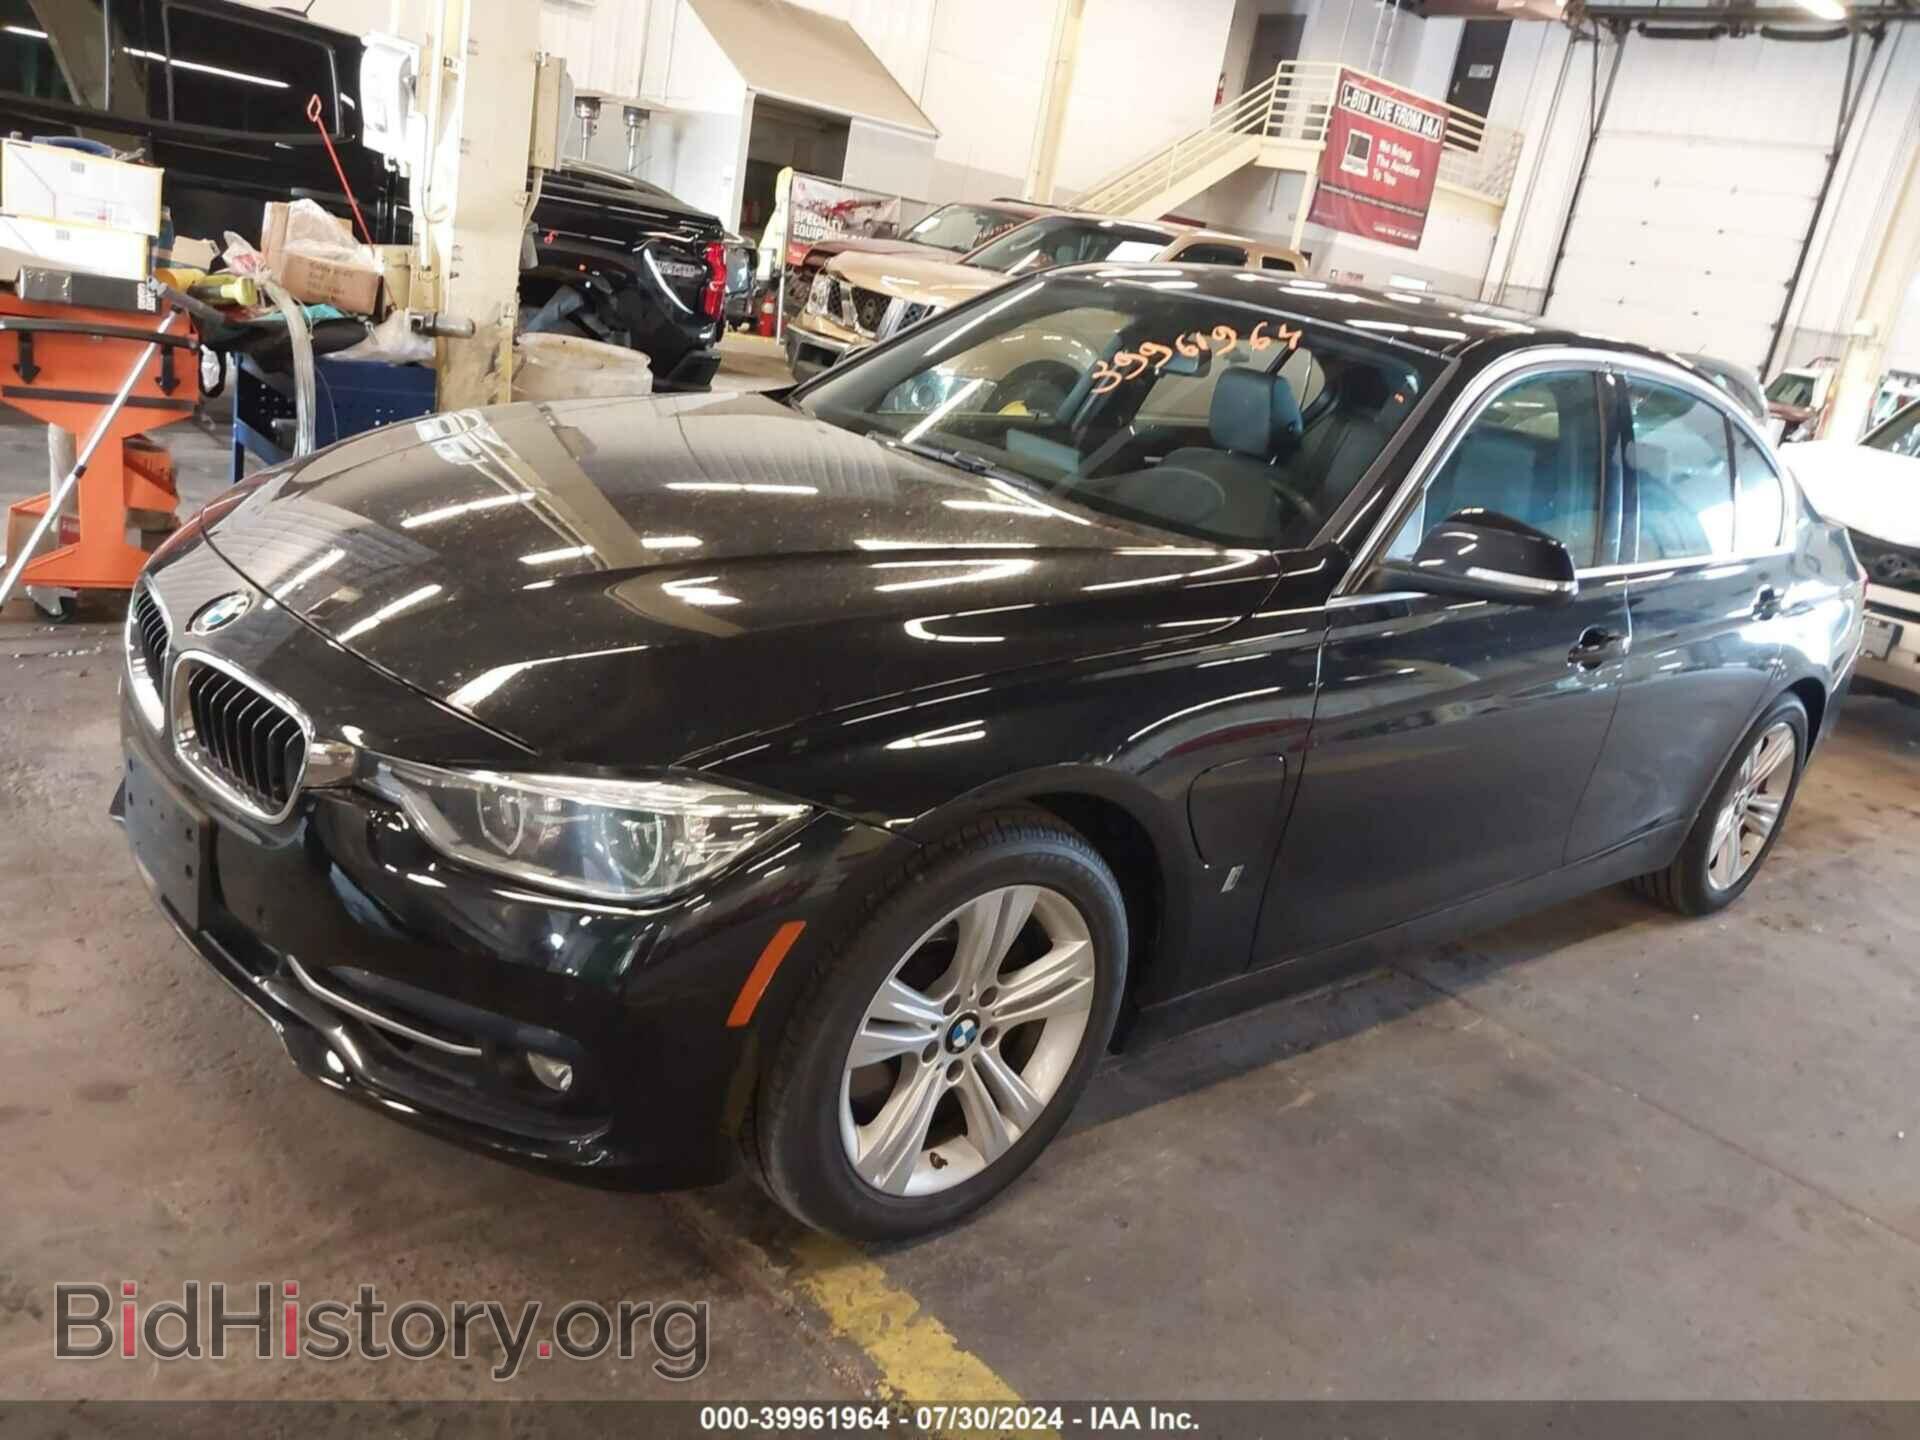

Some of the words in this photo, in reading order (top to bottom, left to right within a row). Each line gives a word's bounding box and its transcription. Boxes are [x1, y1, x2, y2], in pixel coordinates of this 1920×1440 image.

[1342, 86, 1371, 113] I-BID
[1370, 96, 1395, 121] LIVE
[1393, 103, 1422, 133] FROM
[1421, 113, 1441, 139] IAA
[1391, 143, 1412, 164] Bring
[1373, 167, 1382, 181] To
[1376, 153, 1390, 169] The
[1390, 159, 1421, 179] Auction
[793, 209, 849, 232] SPECIALTY
